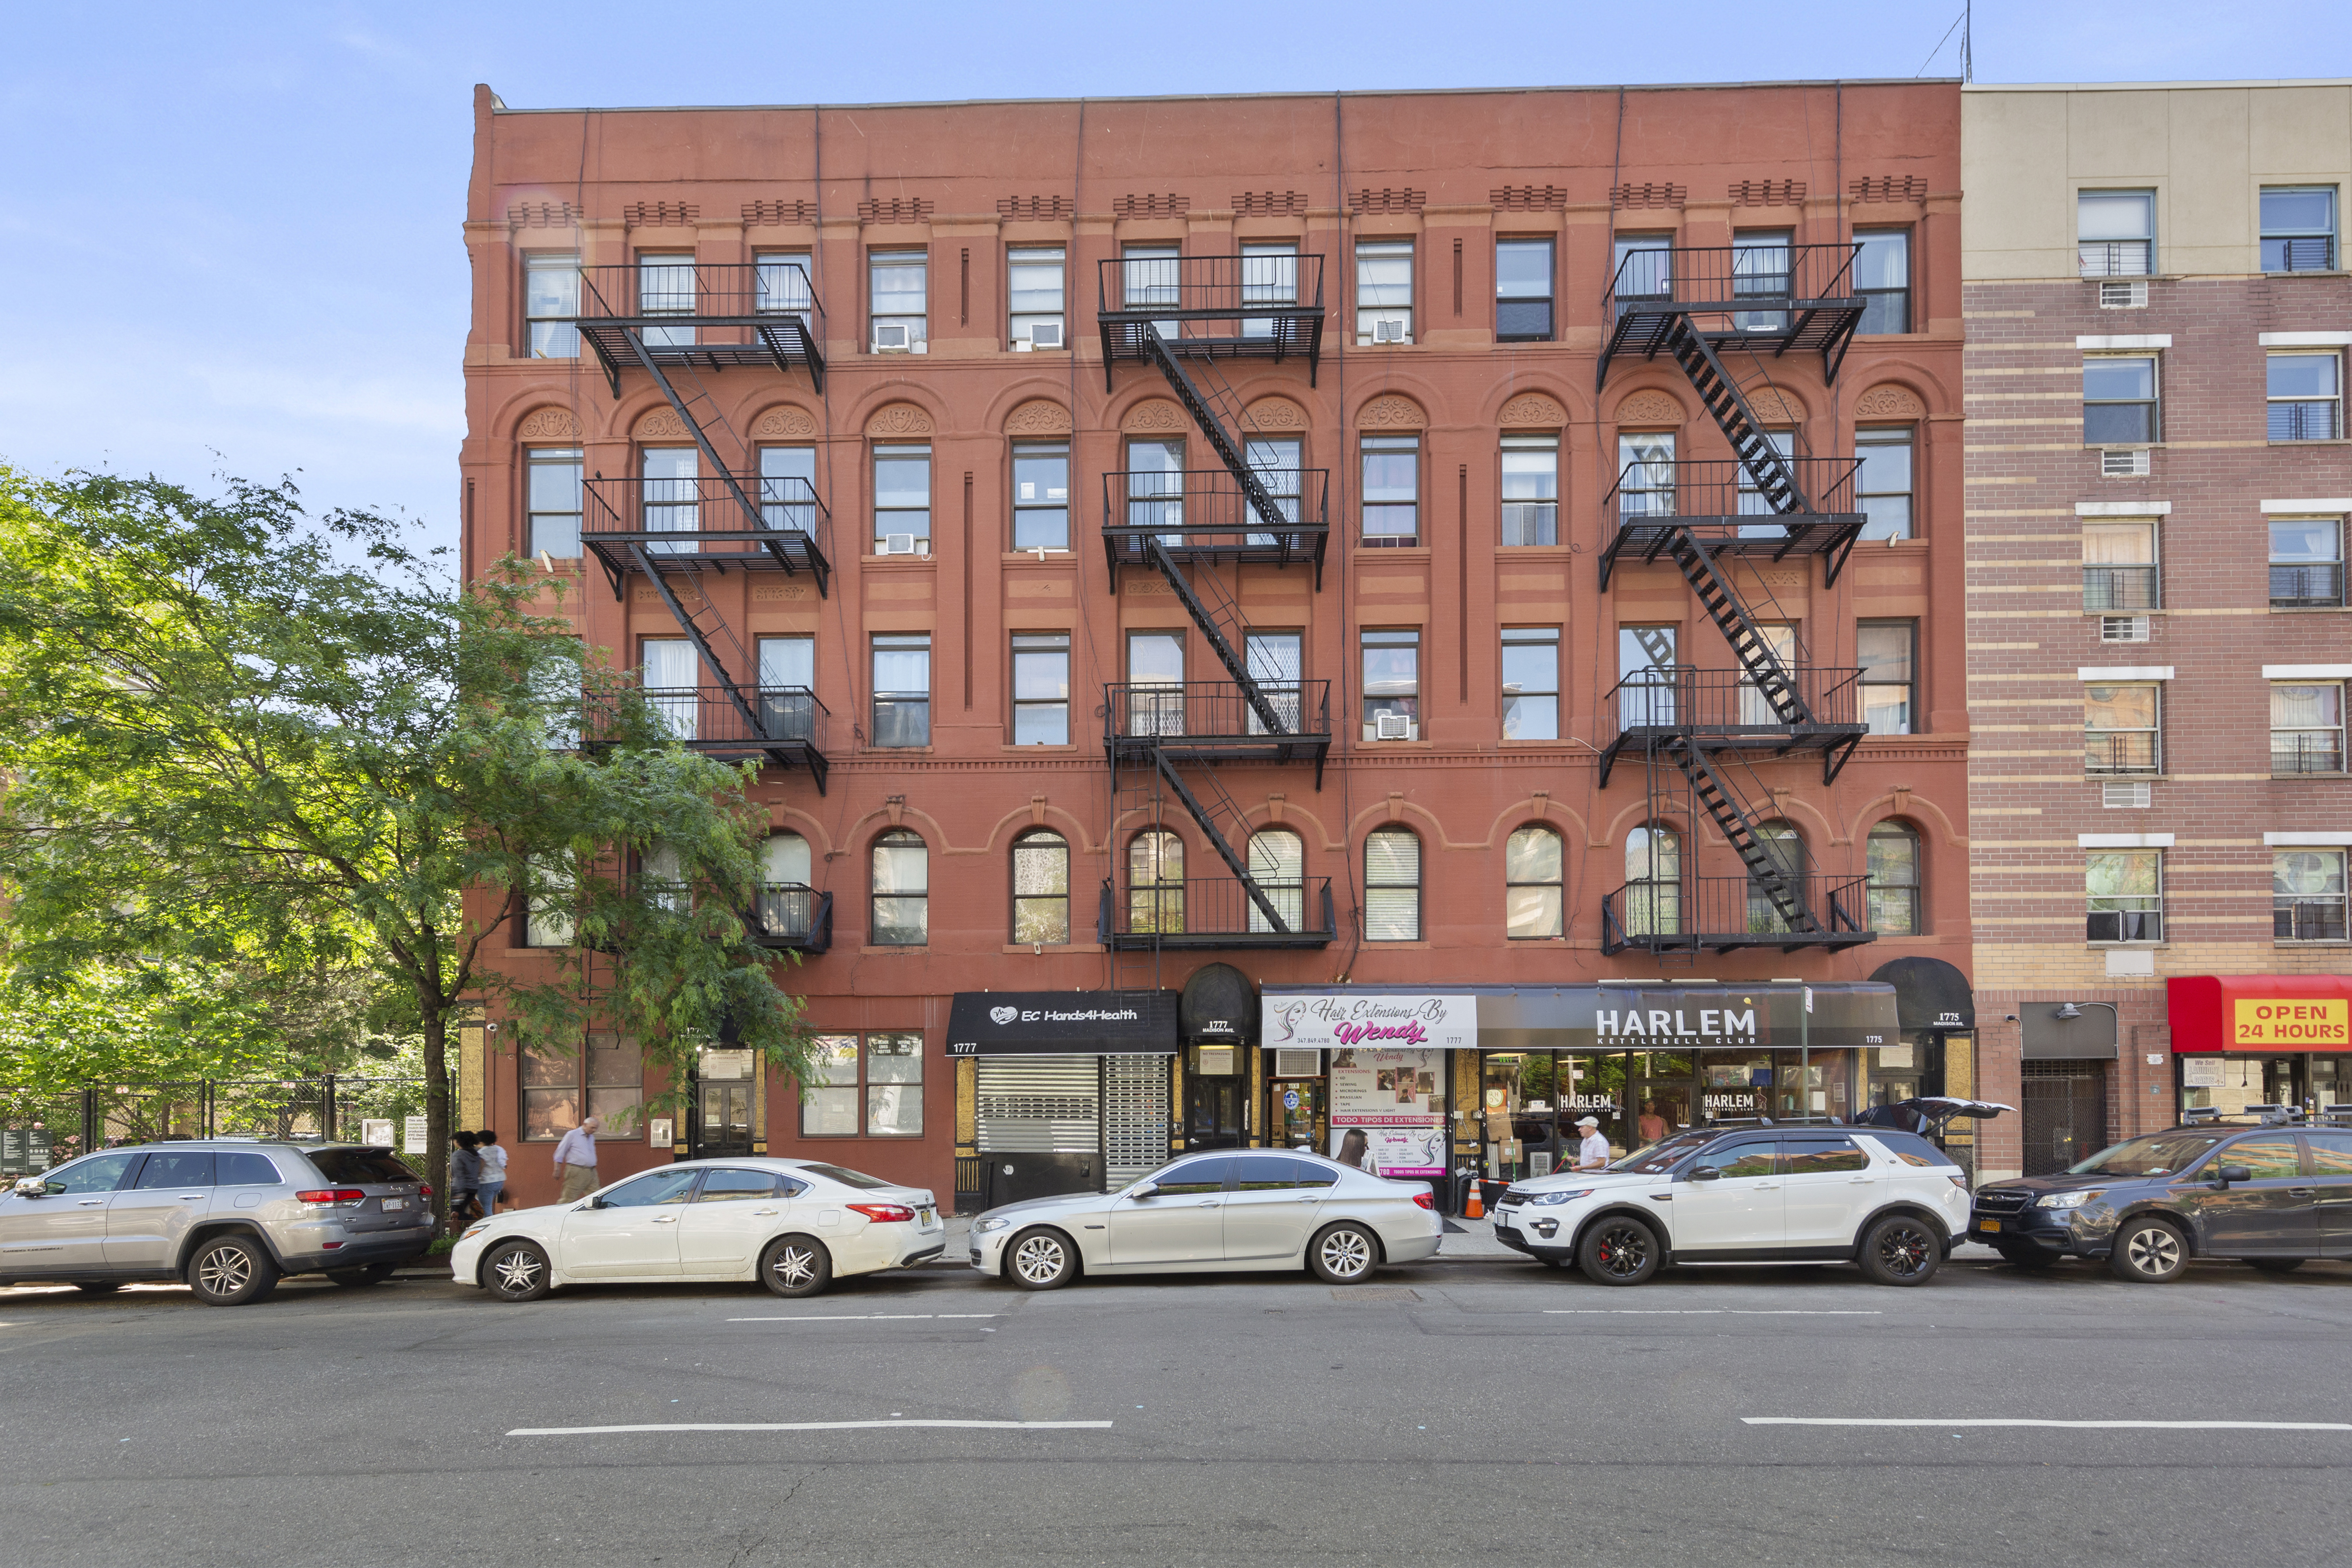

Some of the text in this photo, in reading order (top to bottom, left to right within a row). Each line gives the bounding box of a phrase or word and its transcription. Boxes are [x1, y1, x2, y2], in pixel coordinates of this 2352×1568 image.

[1022, 1009, 1138, 1021] EC Hands4Health
[1310, 997, 1448, 1024] Hair Extensions By
[2256, 1006, 2327, 1020] OPEN
[1596, 1009, 1755, 1036] HARLEM
[1939, 1013, 1959, 1021] 1775
[1334, 1019, 1428, 1045] Wendy
[2239, 1024, 2345, 1038] 24 HOURS
[954, 1043, 977, 1053] 1777
[1374, 1052, 1403, 1062] Wendy
[2194, 1076, 2215, 1084] CARTS
[1561, 1095, 1611, 1108] HARLEM
[1705, 1095, 1753, 1107] HARLEM
